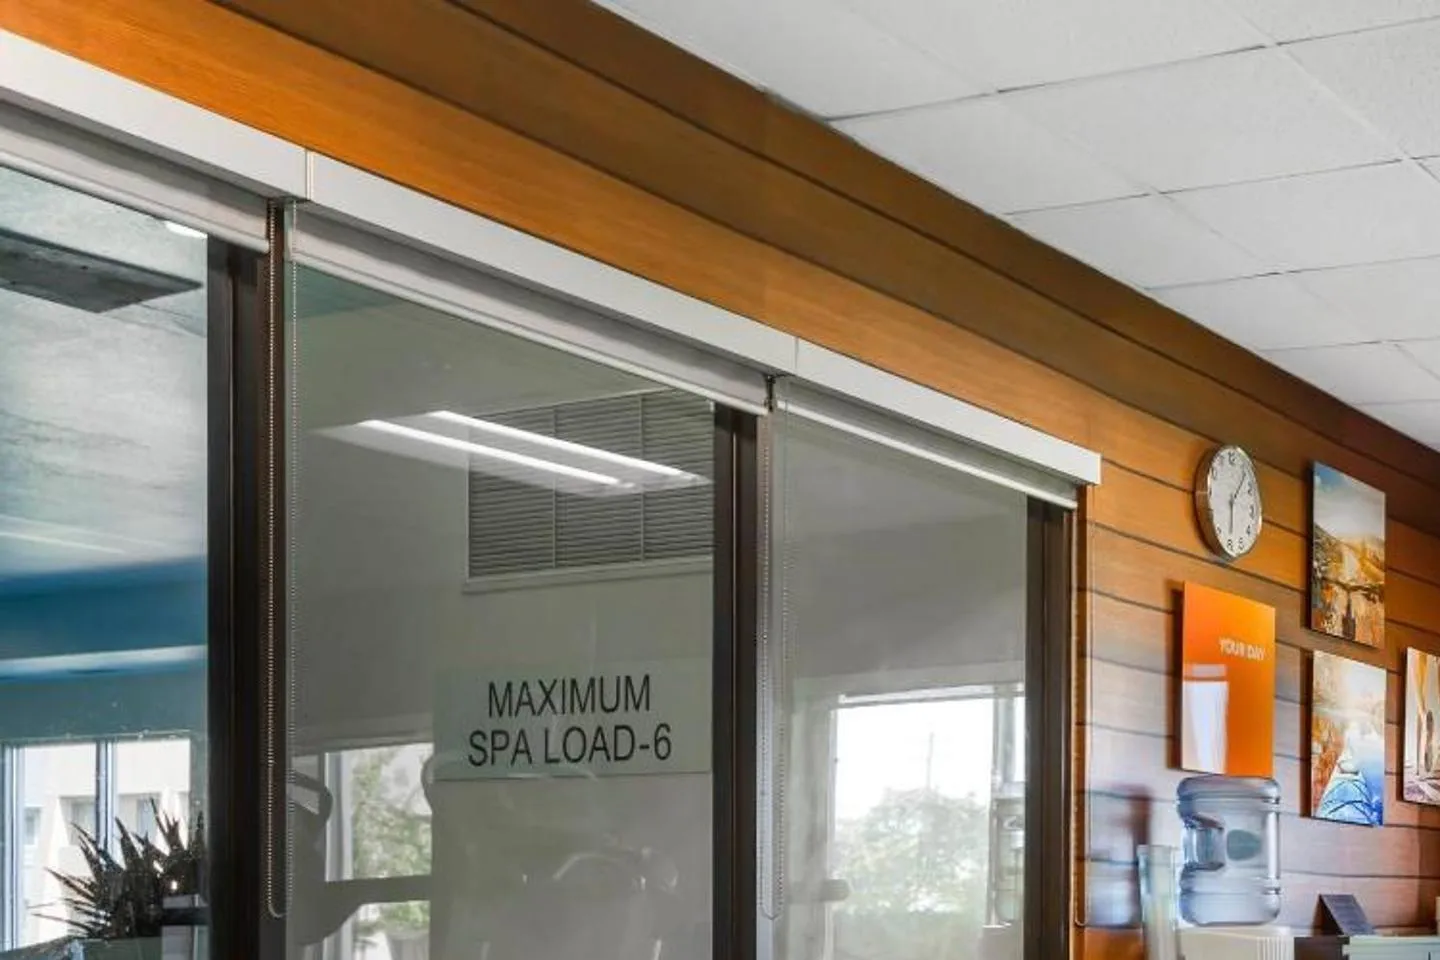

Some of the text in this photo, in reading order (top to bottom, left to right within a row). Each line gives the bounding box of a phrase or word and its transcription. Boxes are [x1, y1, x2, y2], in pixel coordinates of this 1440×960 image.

[1218, 637, 1245, 658] YOUR
[488, 674, 650, 718] MAXIMUM
[467, 723, 672, 767] SPA LOAD-6
